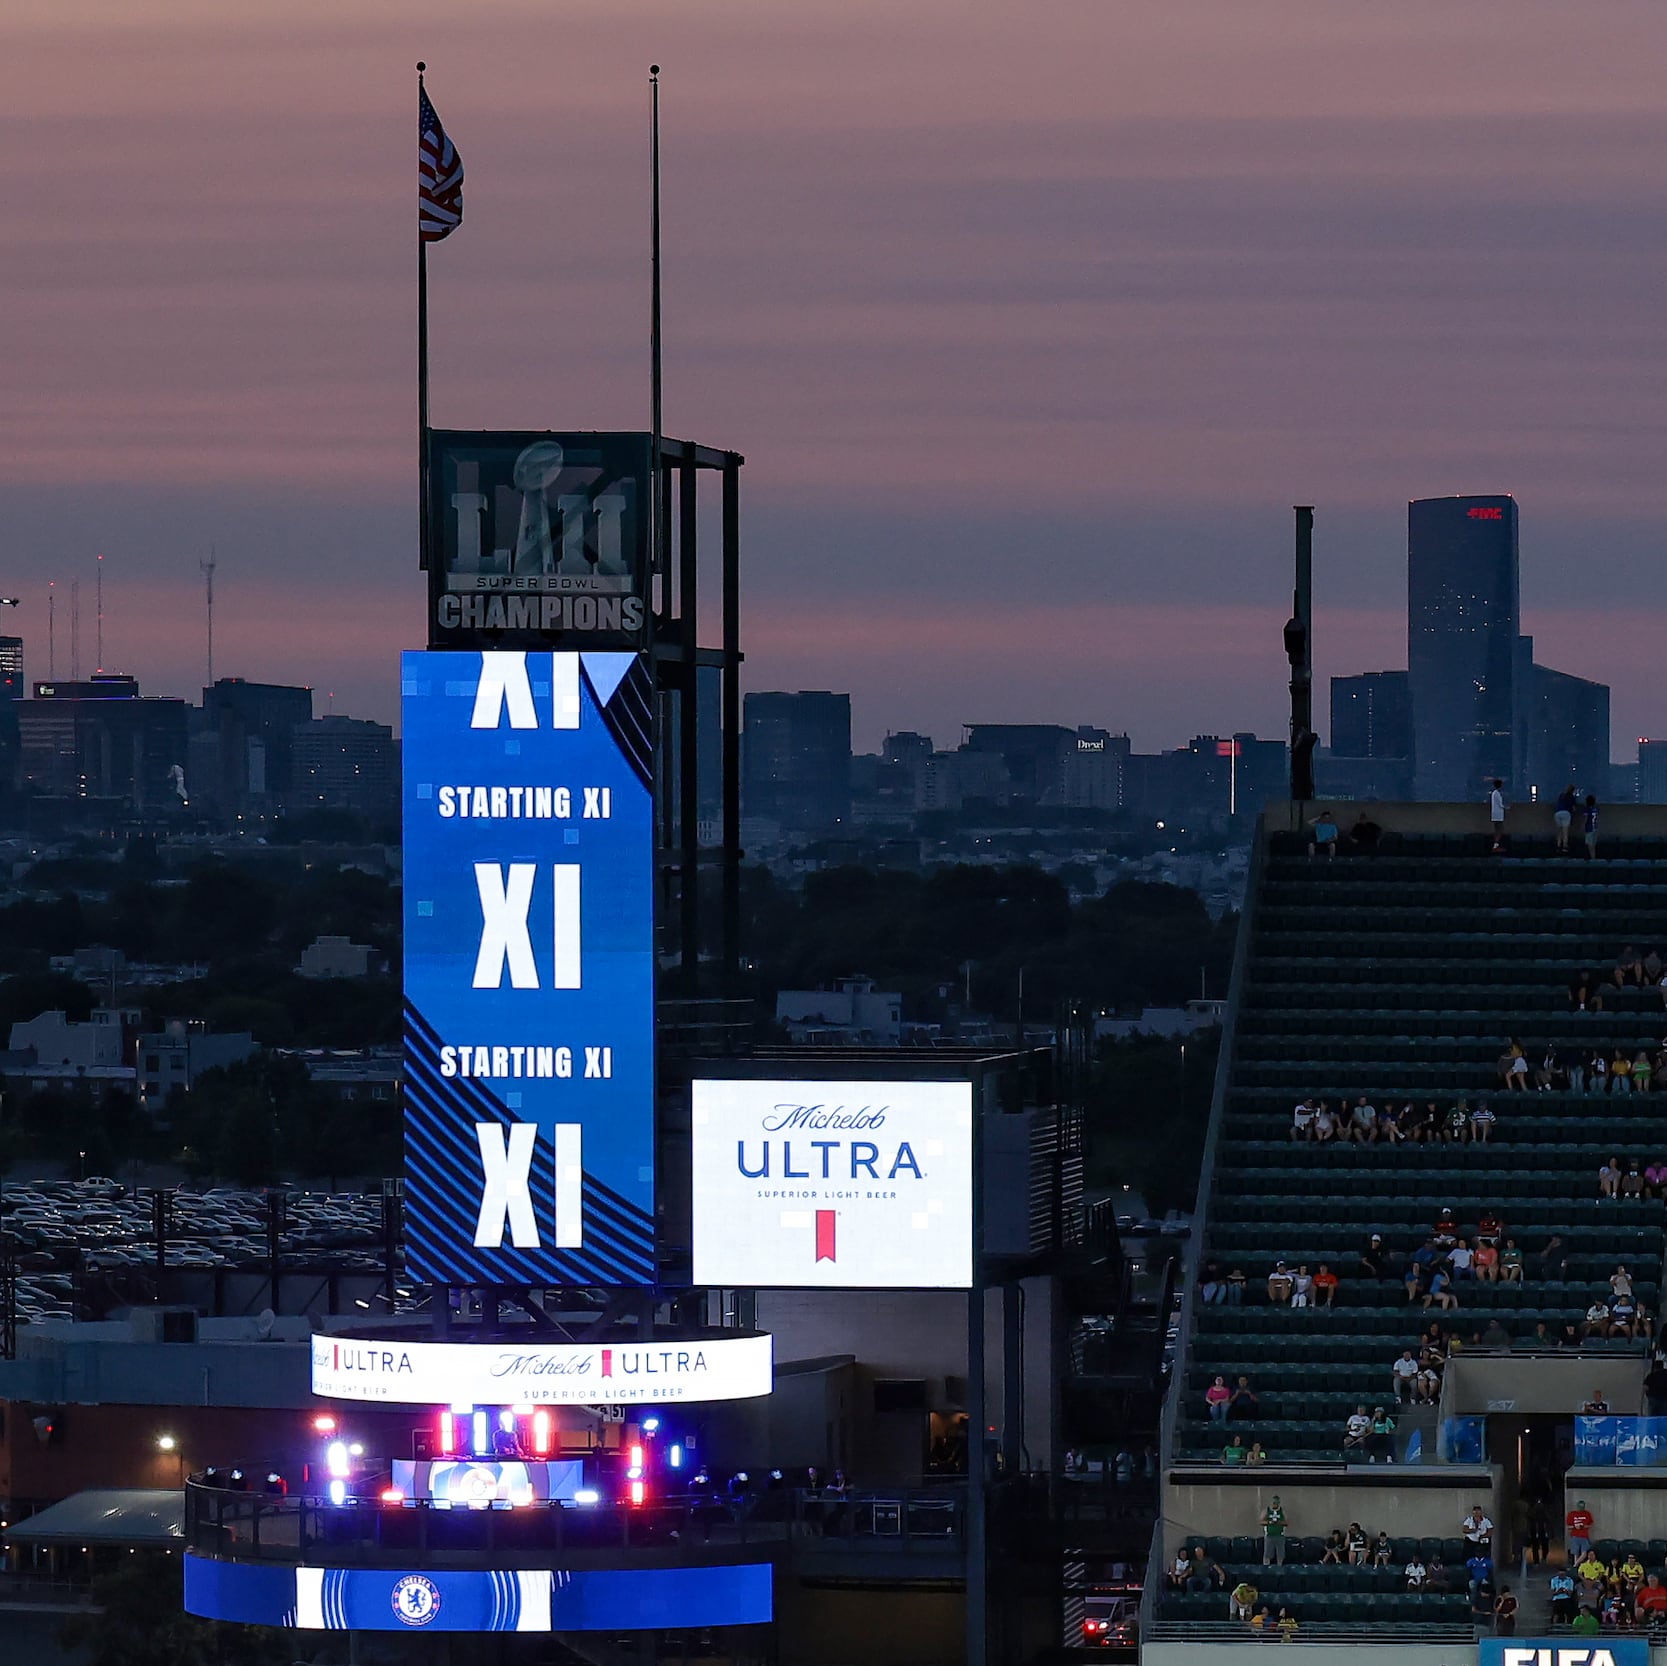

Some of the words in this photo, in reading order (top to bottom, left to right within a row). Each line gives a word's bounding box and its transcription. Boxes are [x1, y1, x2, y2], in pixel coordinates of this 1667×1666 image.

[477, 576, 538, 589] SUPER
[548, 576, 599, 589] BOWL
[438, 594, 643, 630] CHAMPIONS
[439, 787, 571, 818] STARTING
[583, 787, 610, 818] XI
[472, 864, 581, 989] XI
[440, 1046, 572, 1077] STARTING
[584, 1047, 611, 1078] XI
[763, 1104, 885, 1132] Michelob
[738, 1141, 925, 1179] ULTRA
[475, 1123, 582, 1249] XI
[757, 1190, 817, 1200] SUPERIOR
[825, 1191, 862, 1199] LIGHT
[867, 1191, 896, 1200] BEER
[343, 1349, 412, 1373] ULTRA
[490, 1353, 592, 1377] Michelob
[623, 1351, 707, 1373] ULTRA
[524, 1390, 596, 1399] SUPERIOR
[605, 1390, 645, 1398] LIGHT
[654, 1388, 684, 1397] BEER
